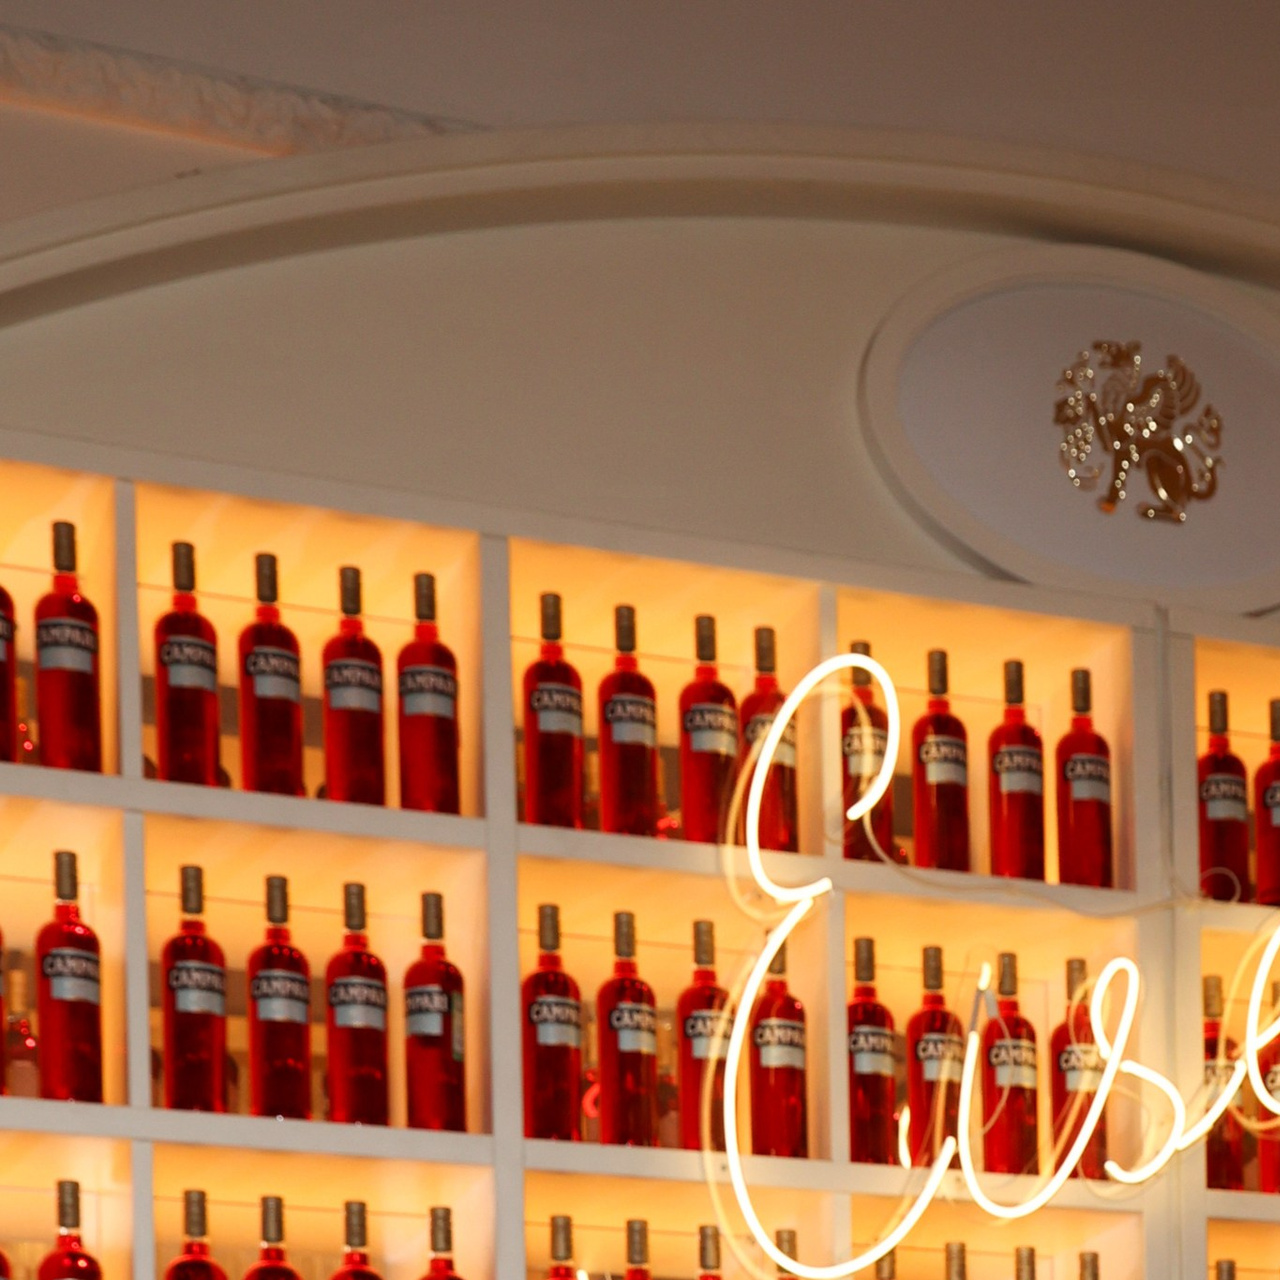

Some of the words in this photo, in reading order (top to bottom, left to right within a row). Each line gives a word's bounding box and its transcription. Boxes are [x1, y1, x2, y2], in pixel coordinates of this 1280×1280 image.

[162, 644, 216, 666] CAMPA
[247, 655, 299, 677] CAMPA
[532, 690, 582, 711] CAMPA
[606, 701, 655, 722] CAMPA
[686, 711, 737, 732] CAMPA
[921, 744, 967, 762] CAMPA
[995, 750, 1043, 772] CAMPA
[1066, 758, 1110, 781] CAMPA
[1202, 781, 1247, 799] CAMPA
[45, 955, 98, 977] CAMPA
[170, 966, 224, 990] CAMPA
[253, 976, 309, 998] CAMPAR
[331, 985, 386, 1006] CAMPAR
[532, 1003, 580, 1024] CAMPA
[756, 1024, 804, 1046] CAMPA
[851, 1032, 892, 1052] CAMPA
[991, 1046, 1035, 1065] CAMPA
